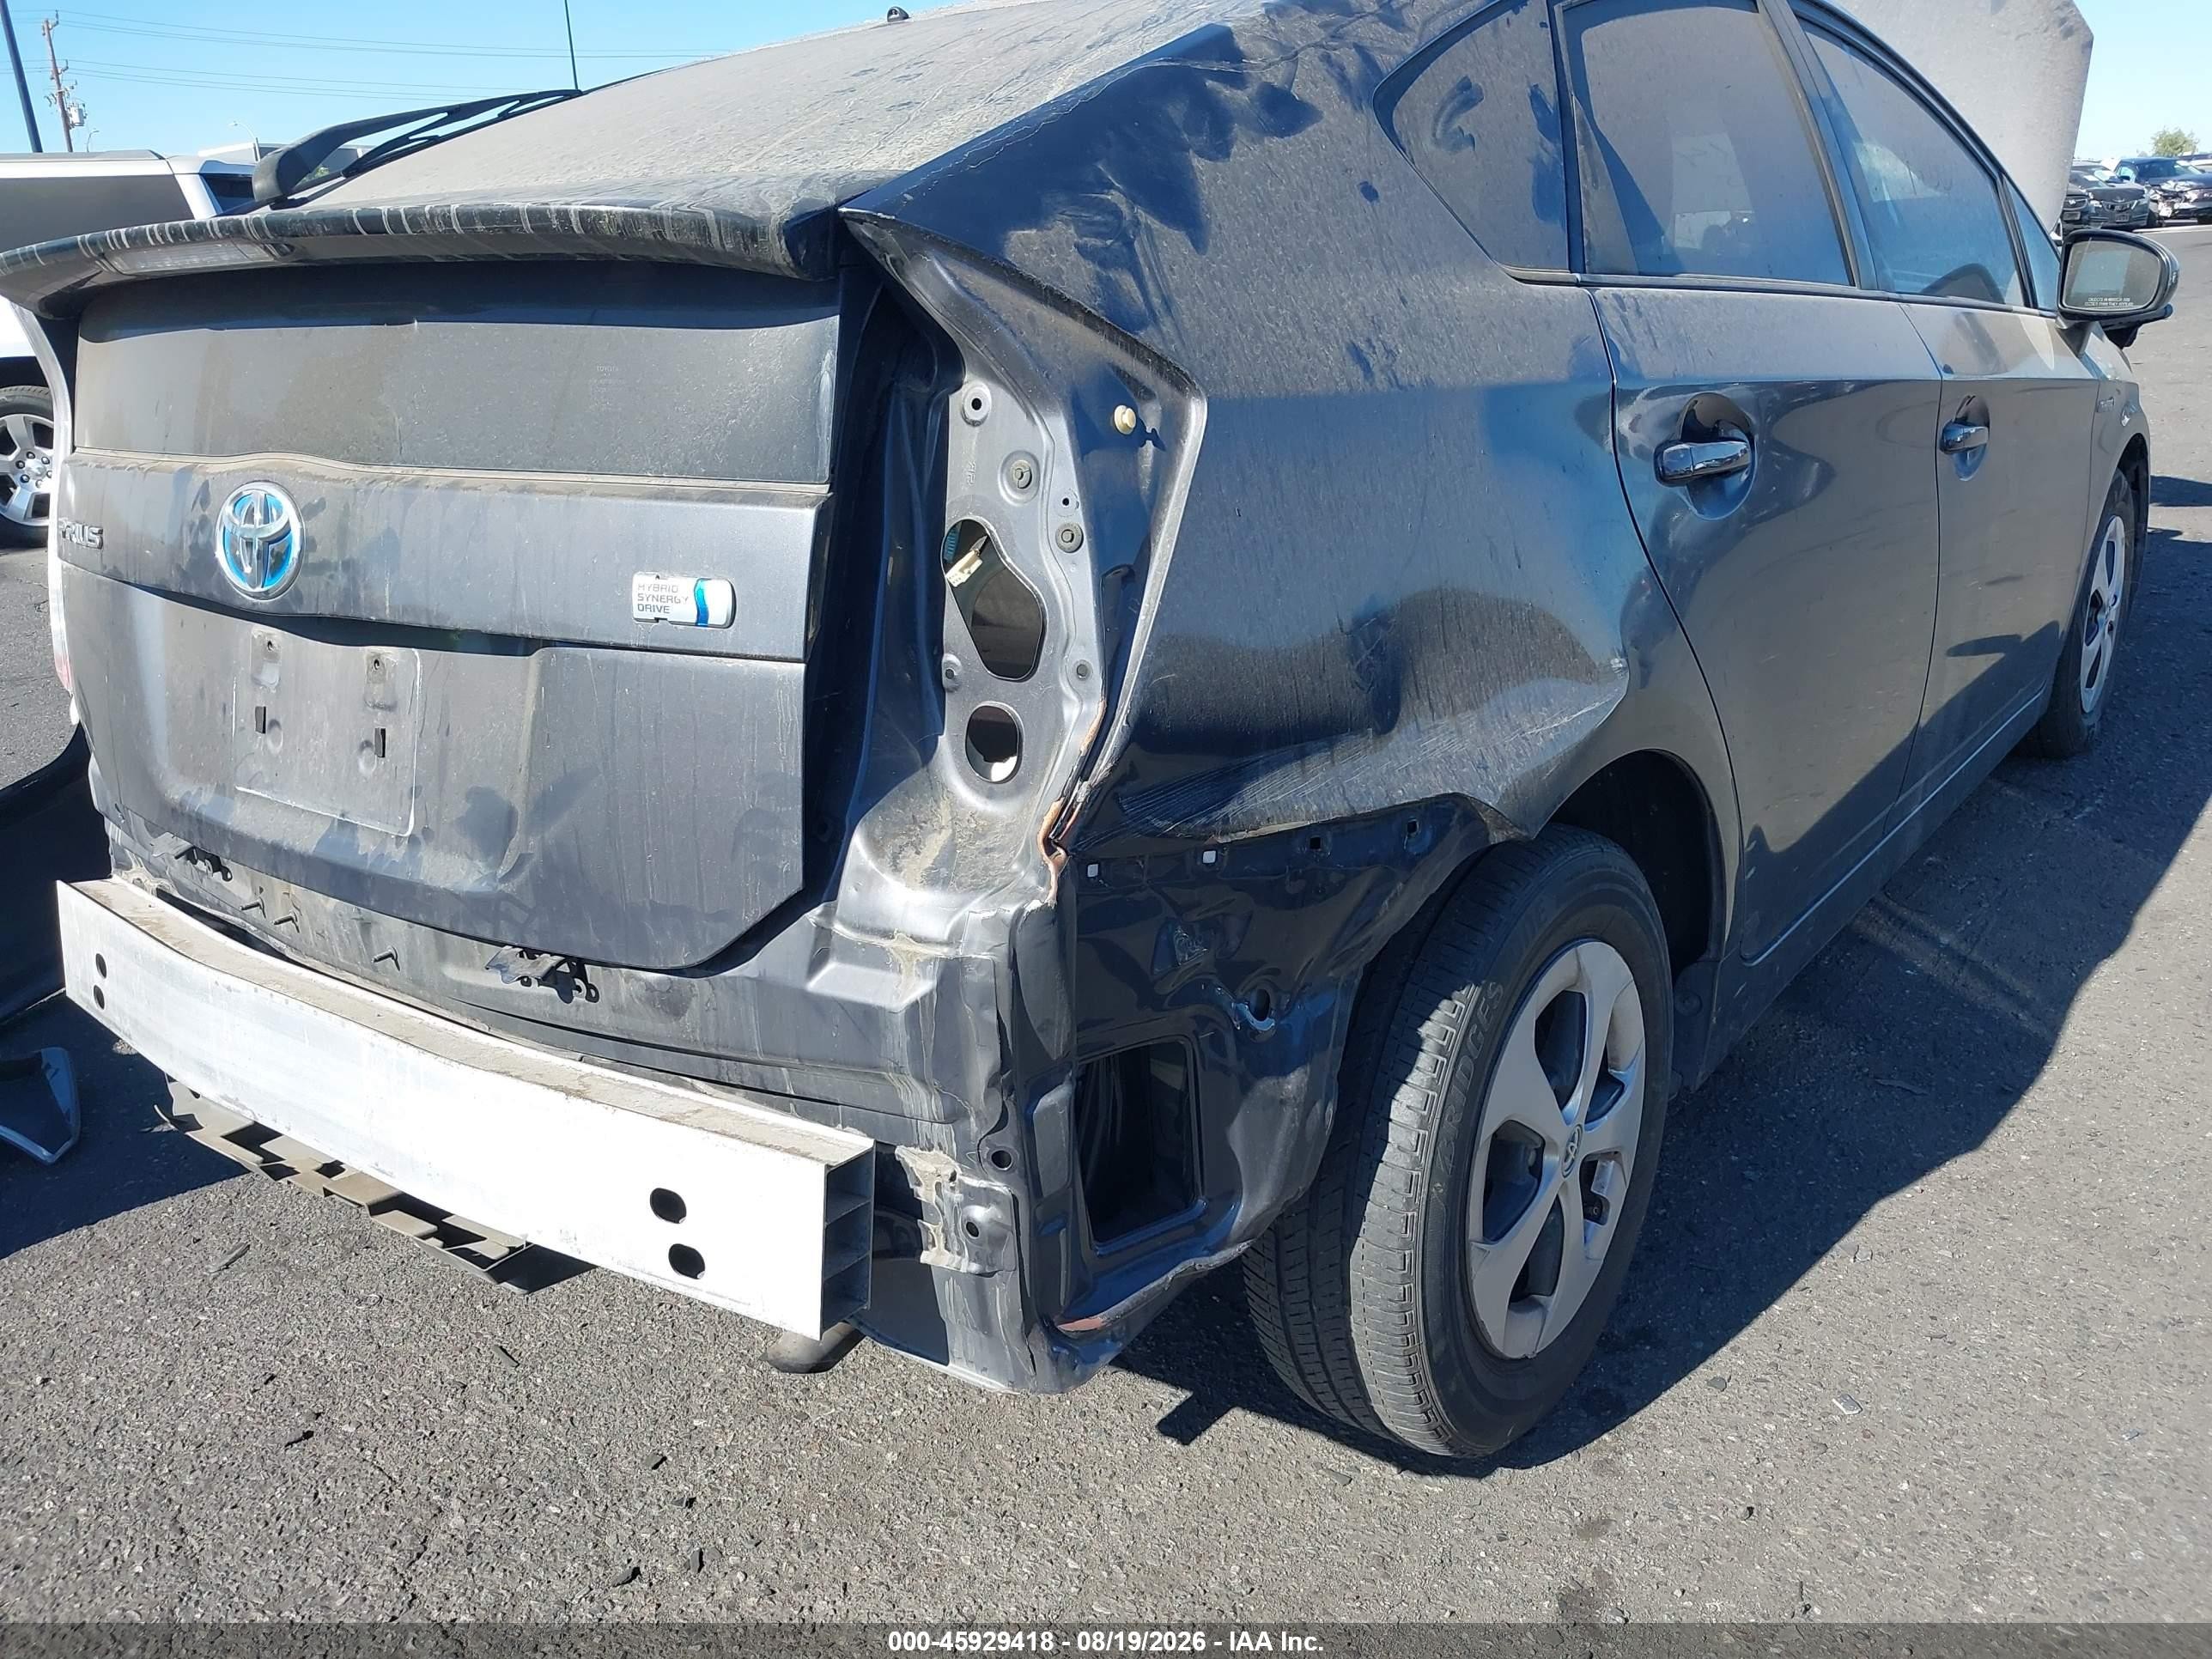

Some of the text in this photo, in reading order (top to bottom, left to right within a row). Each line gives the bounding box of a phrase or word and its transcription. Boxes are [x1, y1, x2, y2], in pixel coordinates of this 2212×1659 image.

[58, 518, 103, 550] PRIUS
[638, 584, 678, 592] HYBRID
[637, 593, 689, 605] SYNERGY
[637, 604, 670, 613] DRIVE
